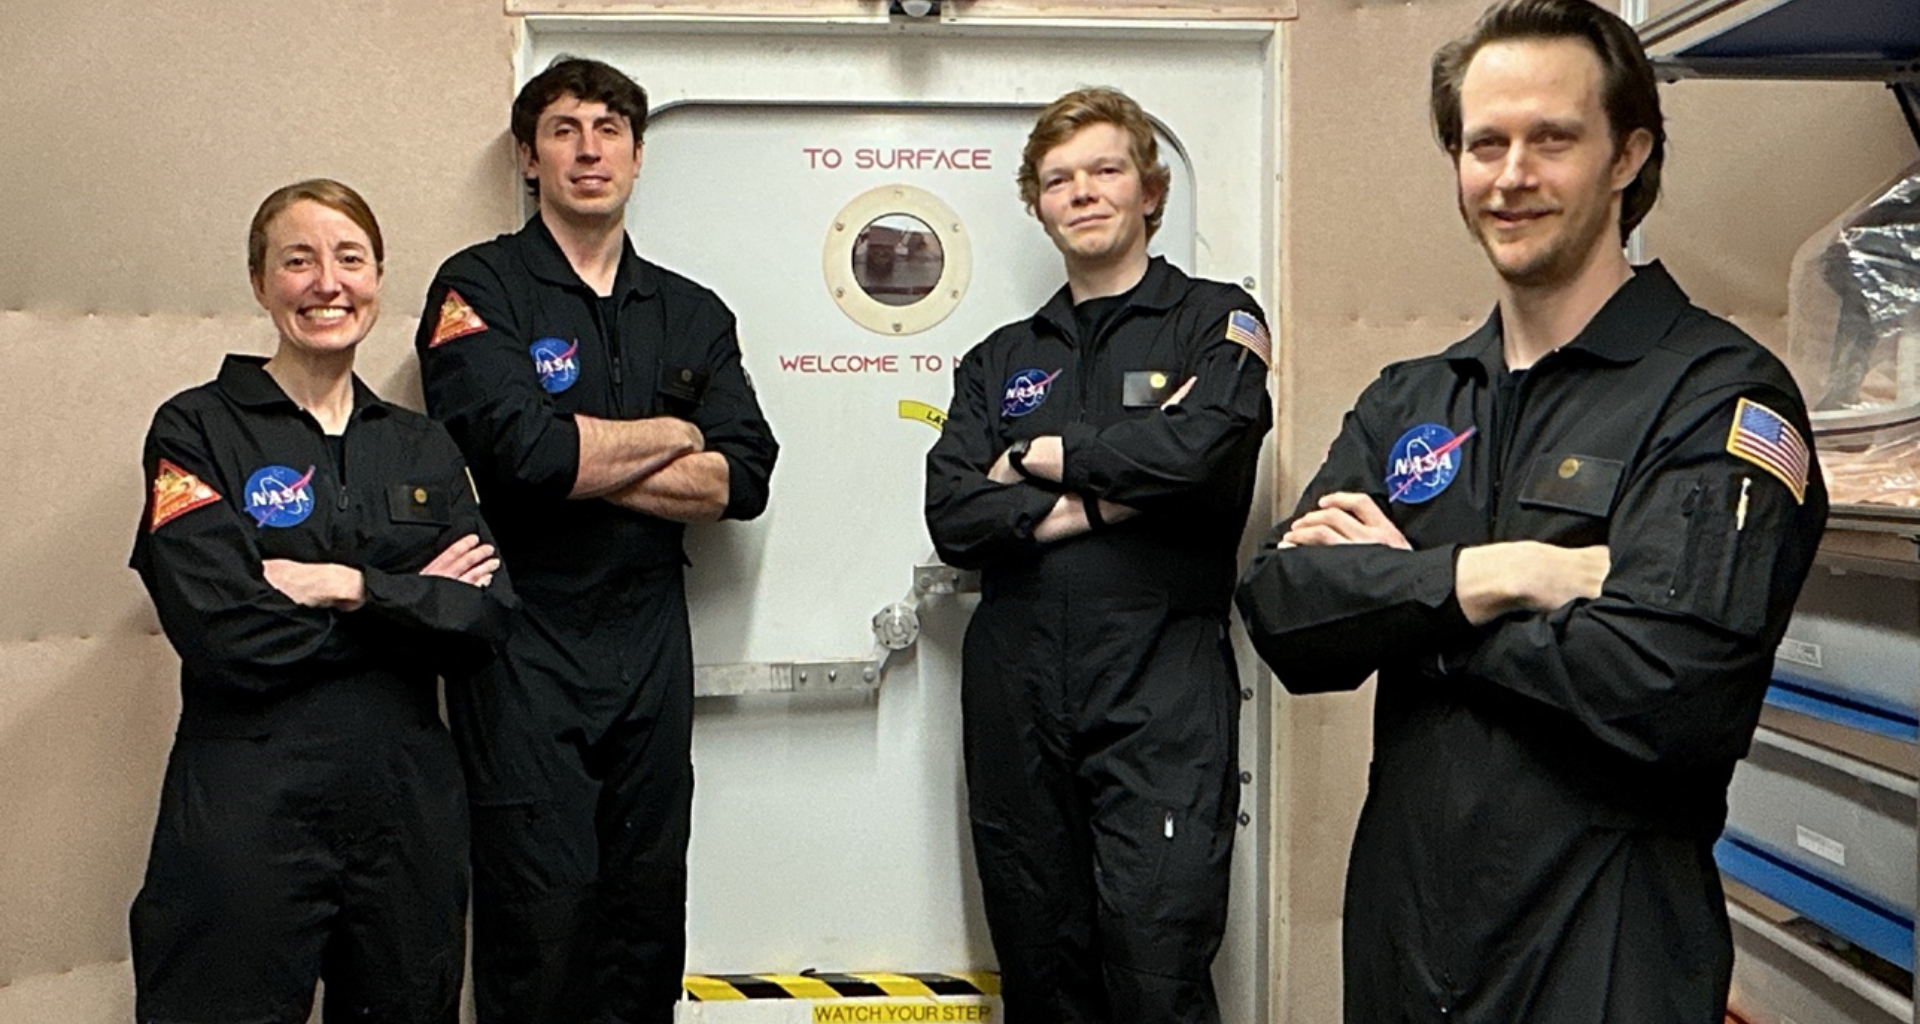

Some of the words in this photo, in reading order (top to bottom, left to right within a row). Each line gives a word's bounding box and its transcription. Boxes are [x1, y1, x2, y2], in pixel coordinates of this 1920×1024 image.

[803, 148, 842, 170] TO
[855, 148, 992, 170] SURFACE
[780, 355, 899, 373] WELCOME
[910, 355, 943, 373] TO
[1005, 384, 1045, 399] NASA
[1393, 451, 1453, 477] NASA
[251, 487, 310, 508] NASA
[814, 1005, 883, 1022] WATCH
[887, 1005, 938, 1022] YOUR
[943, 1005, 992, 1021] STEP
